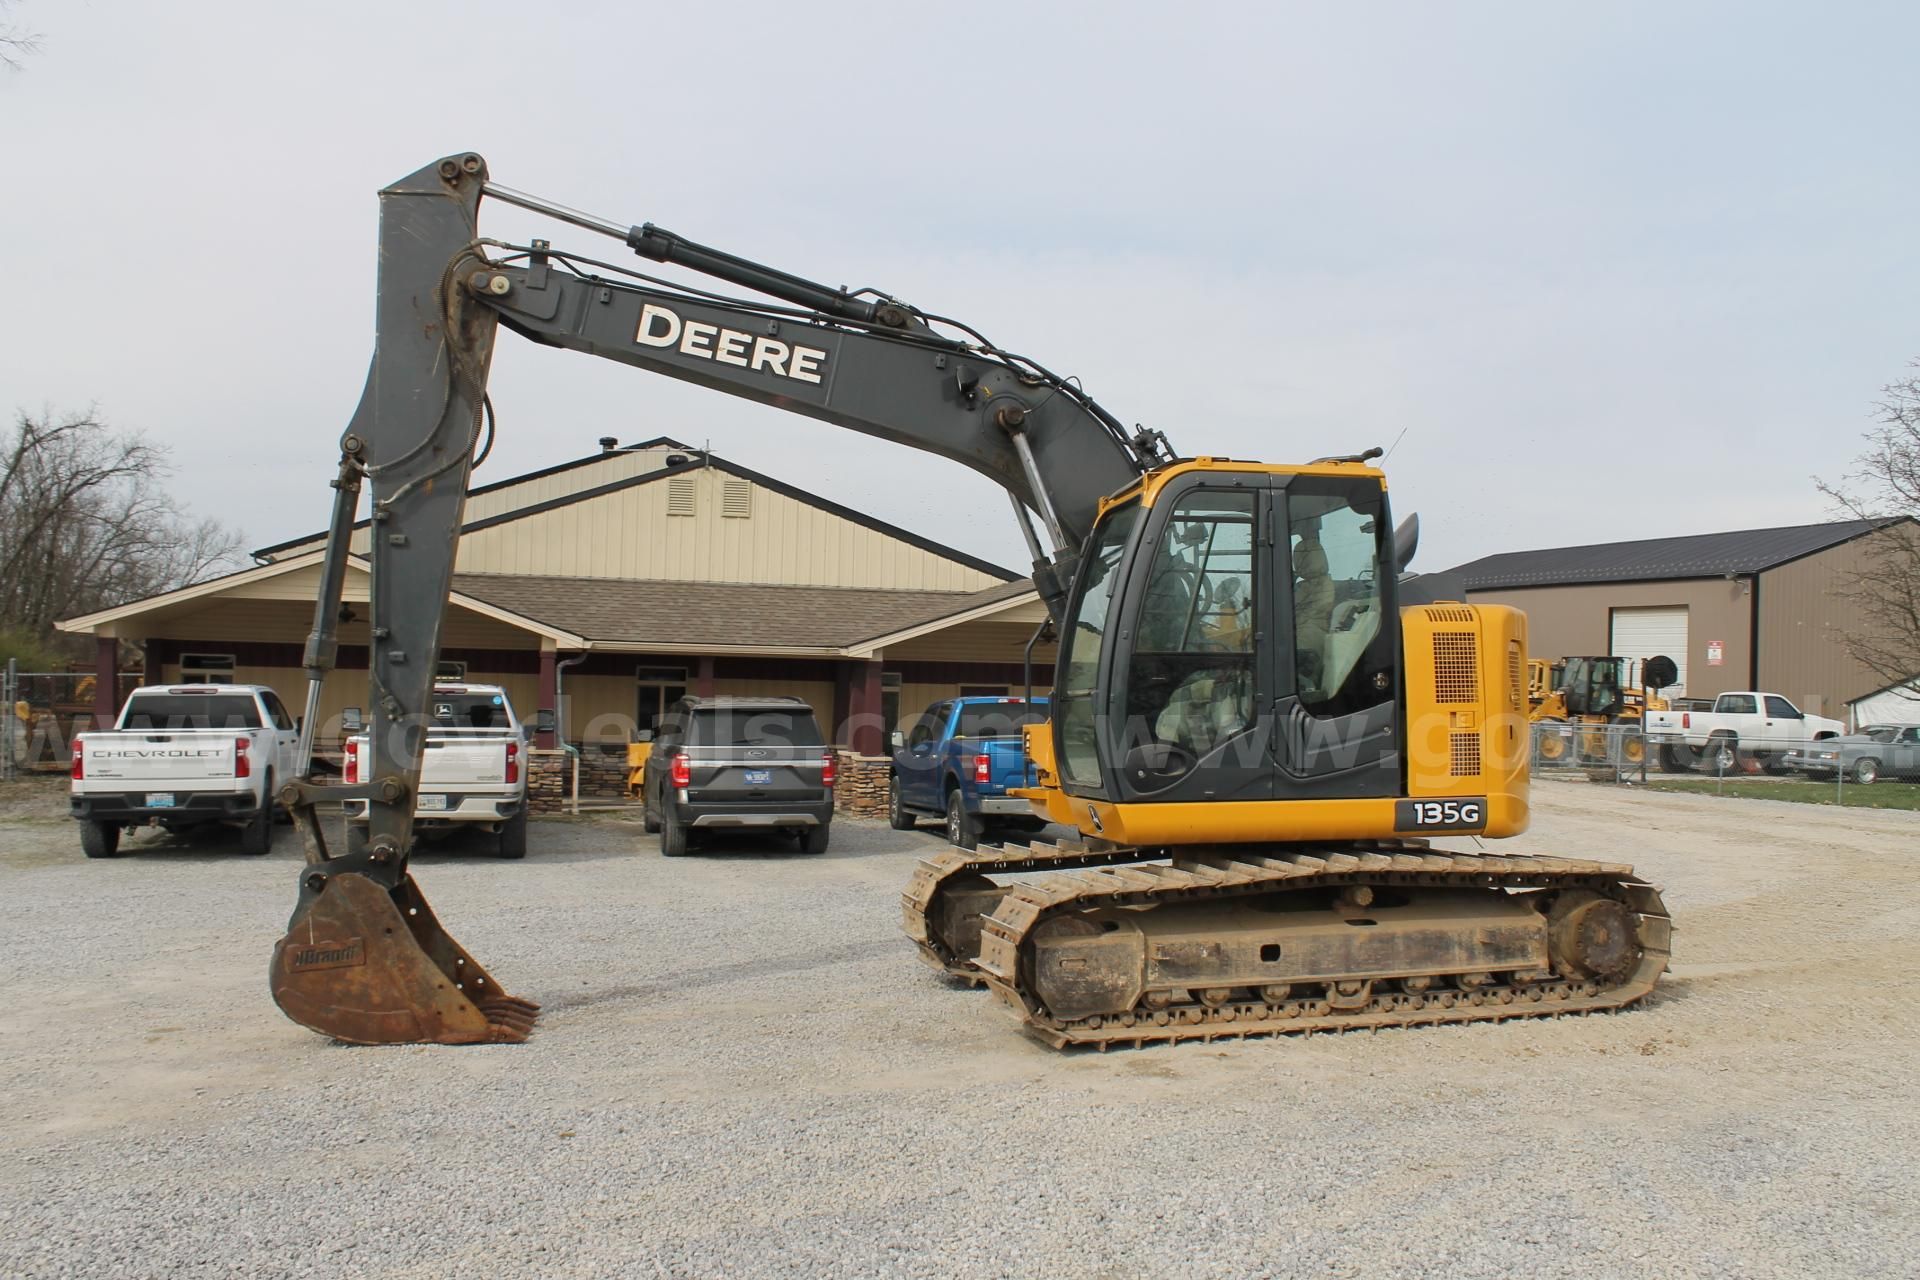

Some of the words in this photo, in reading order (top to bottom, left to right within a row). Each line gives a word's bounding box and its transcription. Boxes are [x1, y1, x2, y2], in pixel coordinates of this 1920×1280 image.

[635, 303, 827, 386] DEERE
[93, 749, 224, 758] CHEVROLET
[1414, 802, 1479, 824] 135G
